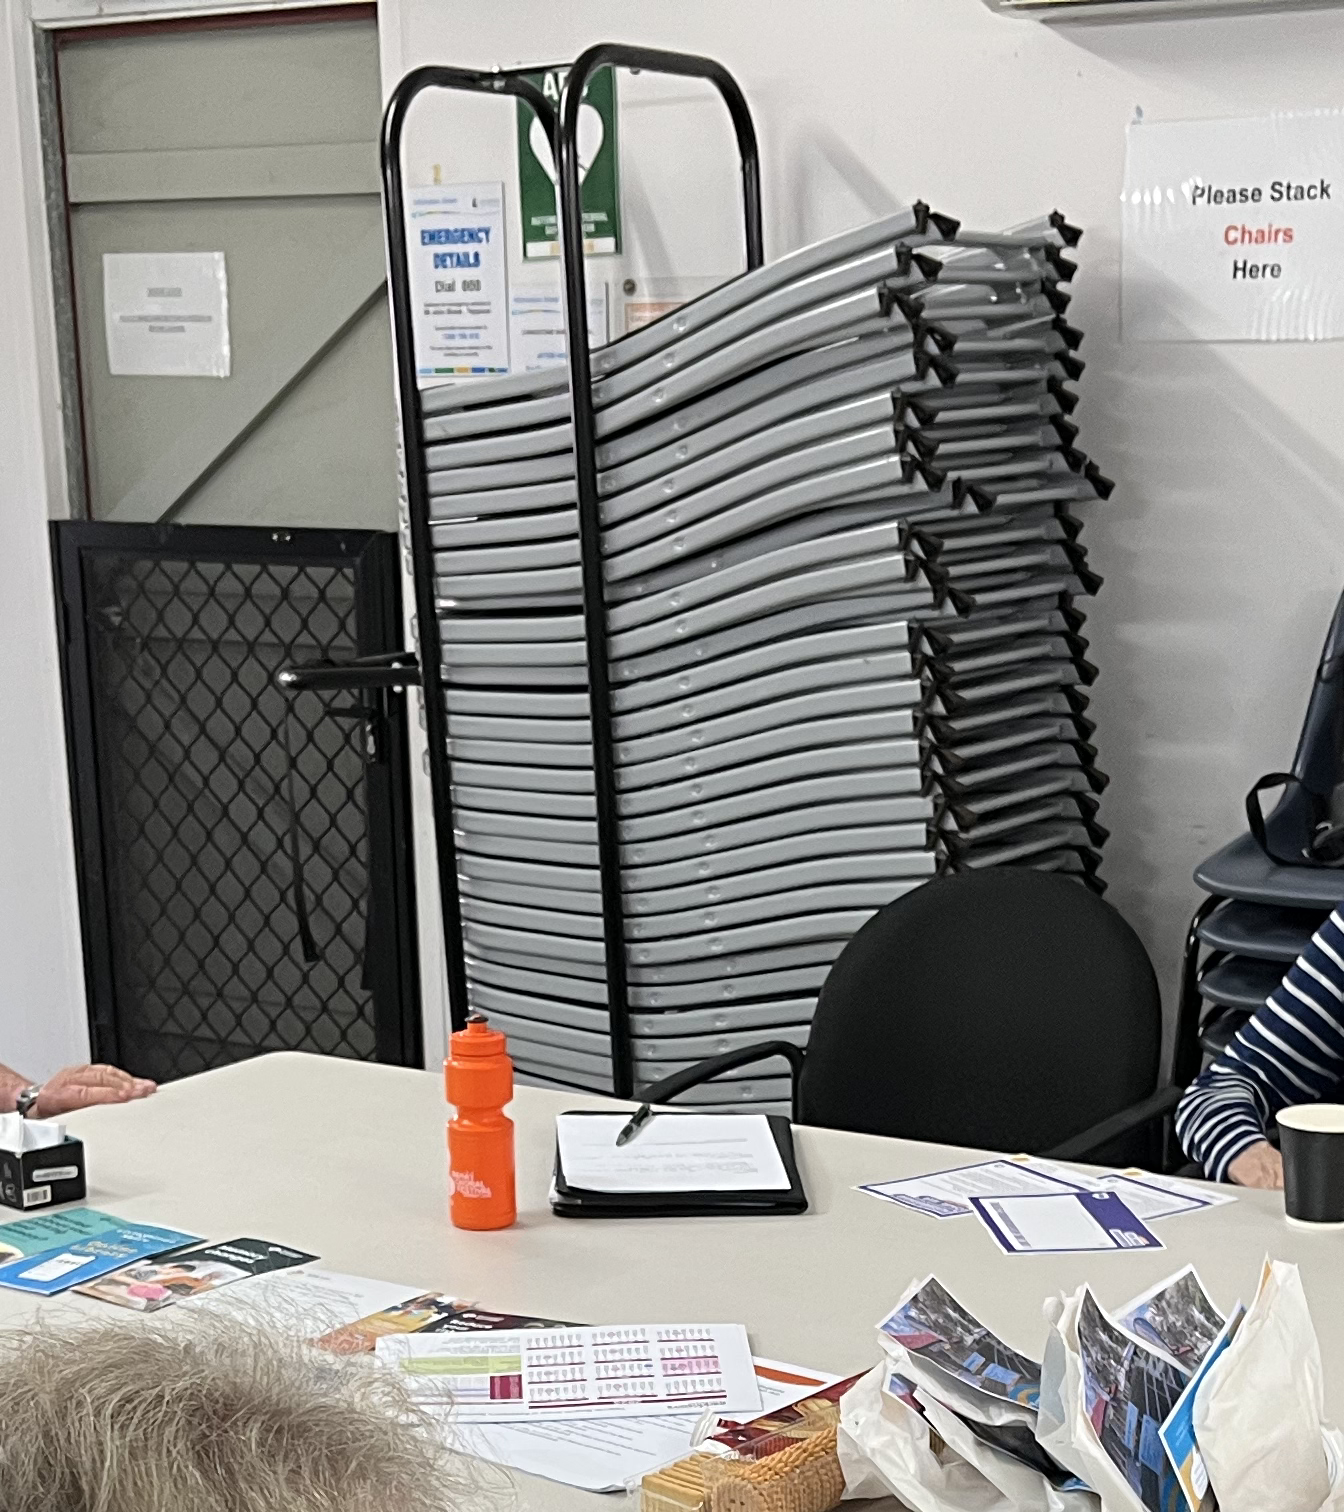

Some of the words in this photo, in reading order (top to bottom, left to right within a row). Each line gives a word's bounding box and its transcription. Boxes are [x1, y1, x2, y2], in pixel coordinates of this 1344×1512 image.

[1191, 183, 1263, 207] Please
[1269, 179, 1332, 202] Stack
[1223, 223, 1295, 246] Chairs
[1232, 259, 1282, 281] Here
